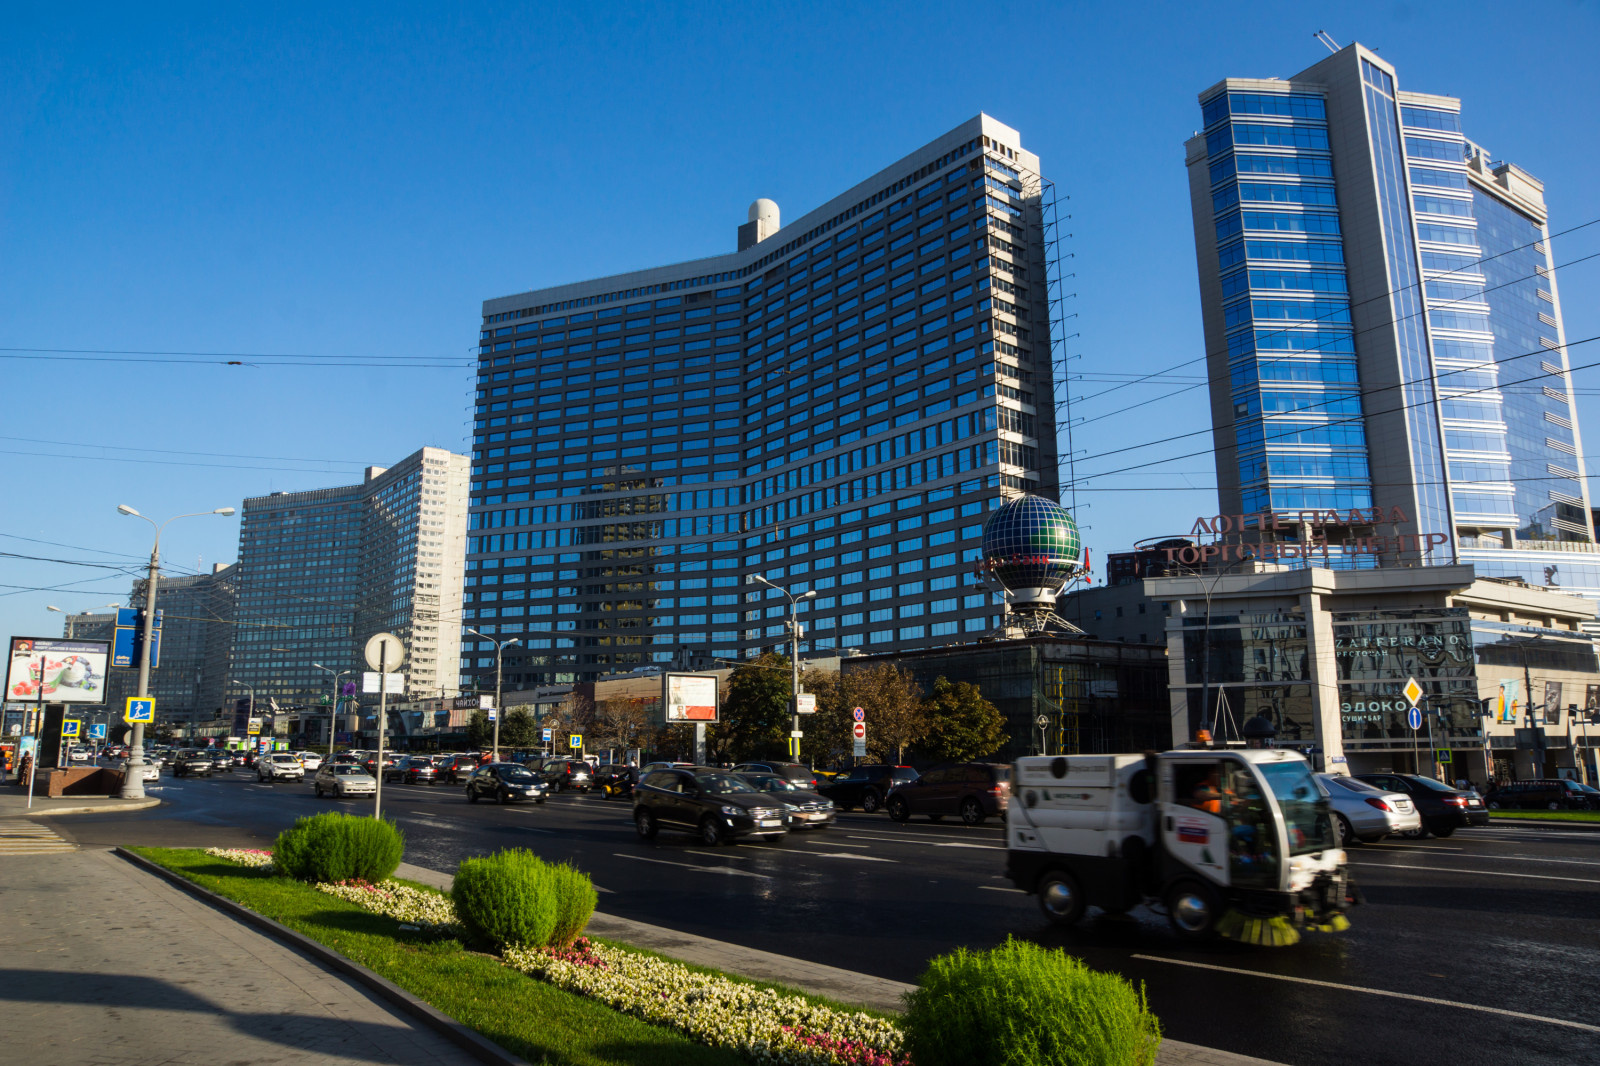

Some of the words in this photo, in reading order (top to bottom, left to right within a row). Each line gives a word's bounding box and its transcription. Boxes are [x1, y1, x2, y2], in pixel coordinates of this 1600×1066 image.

[1190, 511, 1290, 535] ЛОТТЕ
[1298, 505, 1409, 529] ПЛАЗА
[1160, 534, 1329, 565] ТОРГОВЫЙ
[1342, 532, 1449, 556] ЦЕНТР
[1335, 635, 1460, 649] ZAFFERANO
[455, 698, 480, 708] ЧАЙХОН
[1341, 701, 1407, 713] ЭДОКО
